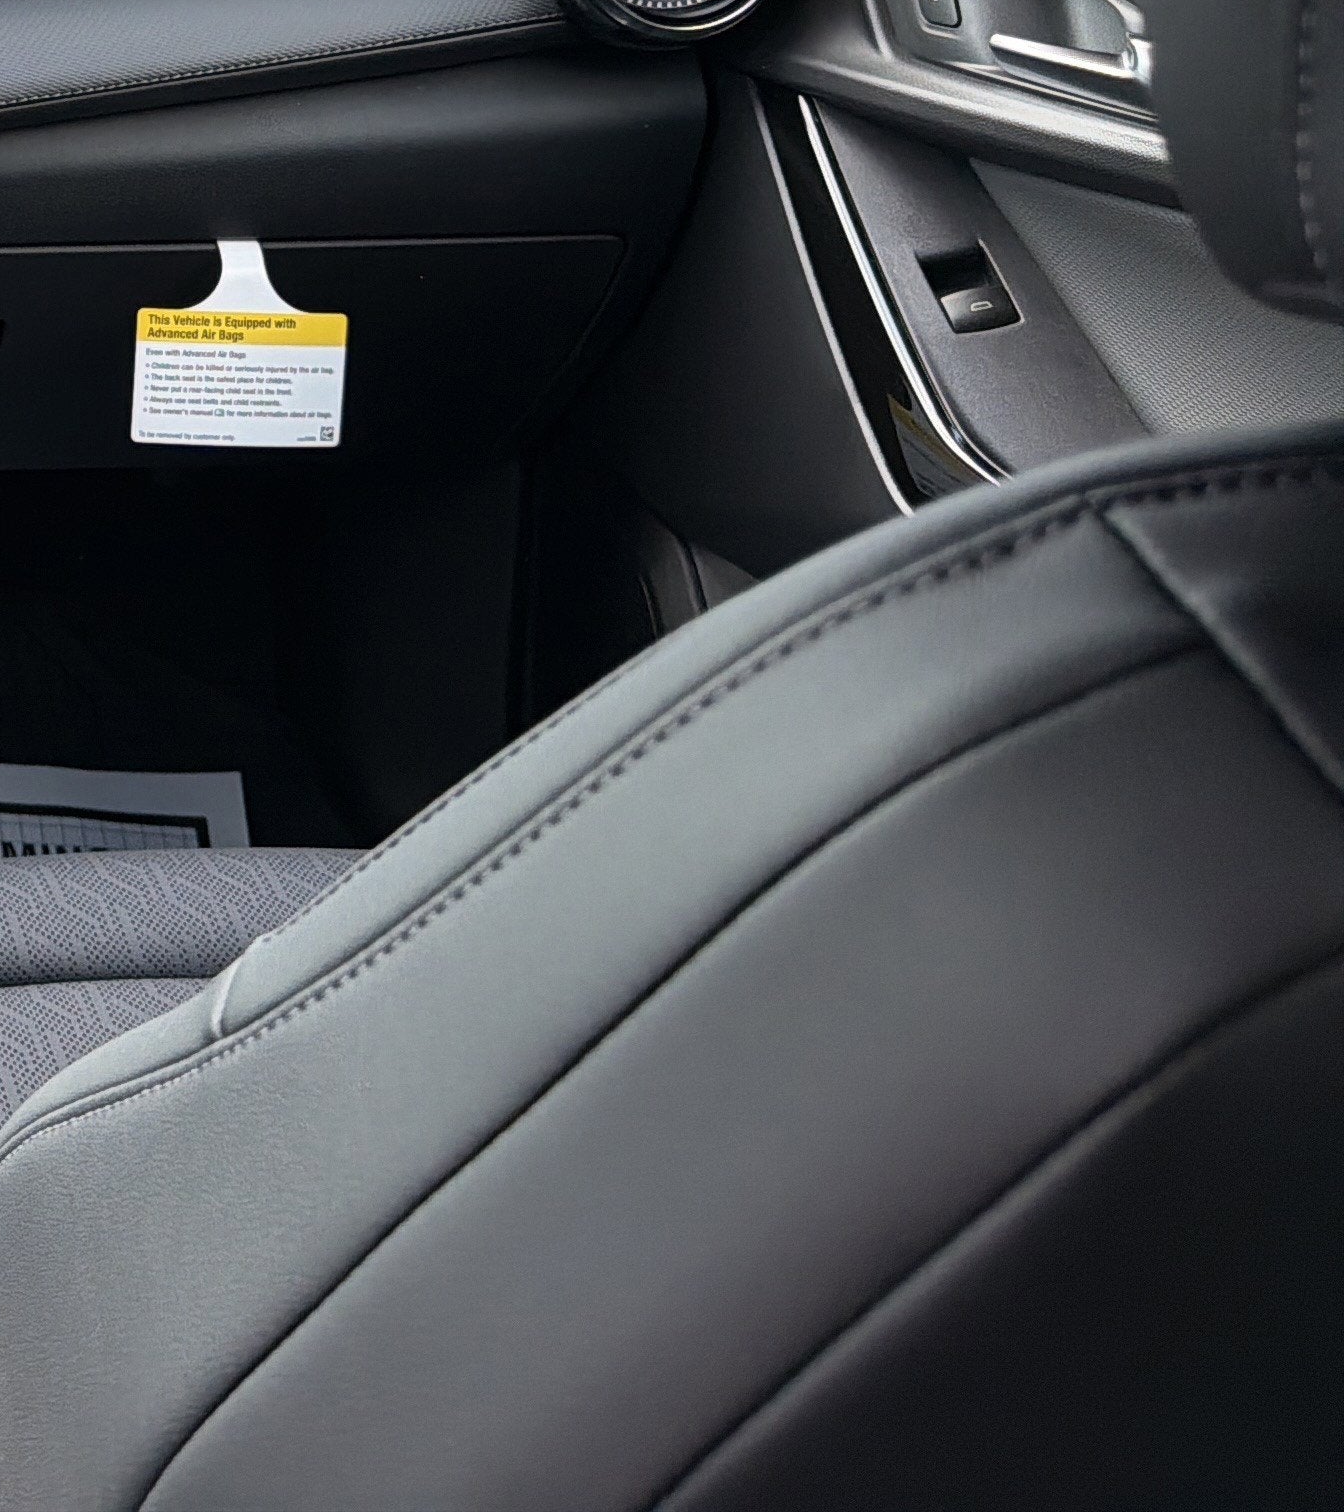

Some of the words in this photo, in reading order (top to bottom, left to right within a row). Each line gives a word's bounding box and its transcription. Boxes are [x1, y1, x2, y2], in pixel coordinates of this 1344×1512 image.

[148, 314, 171, 326] This
[173, 316, 210, 327] Vehicle
[213, 316, 222, 327] is
[224, 316, 272, 331] Equipped
[274, 317, 297, 329] with
[147, 327, 199, 340] Advanced
[201, 329, 217, 340] Air
[218, 330, 245, 342] Bags
[145, 348, 164, 356] Even
[165, 348, 181, 357] with
[182, 349, 216, 358] Advanced
[218, 350, 228, 359] Air
[229, 351, 247, 360] Bags
